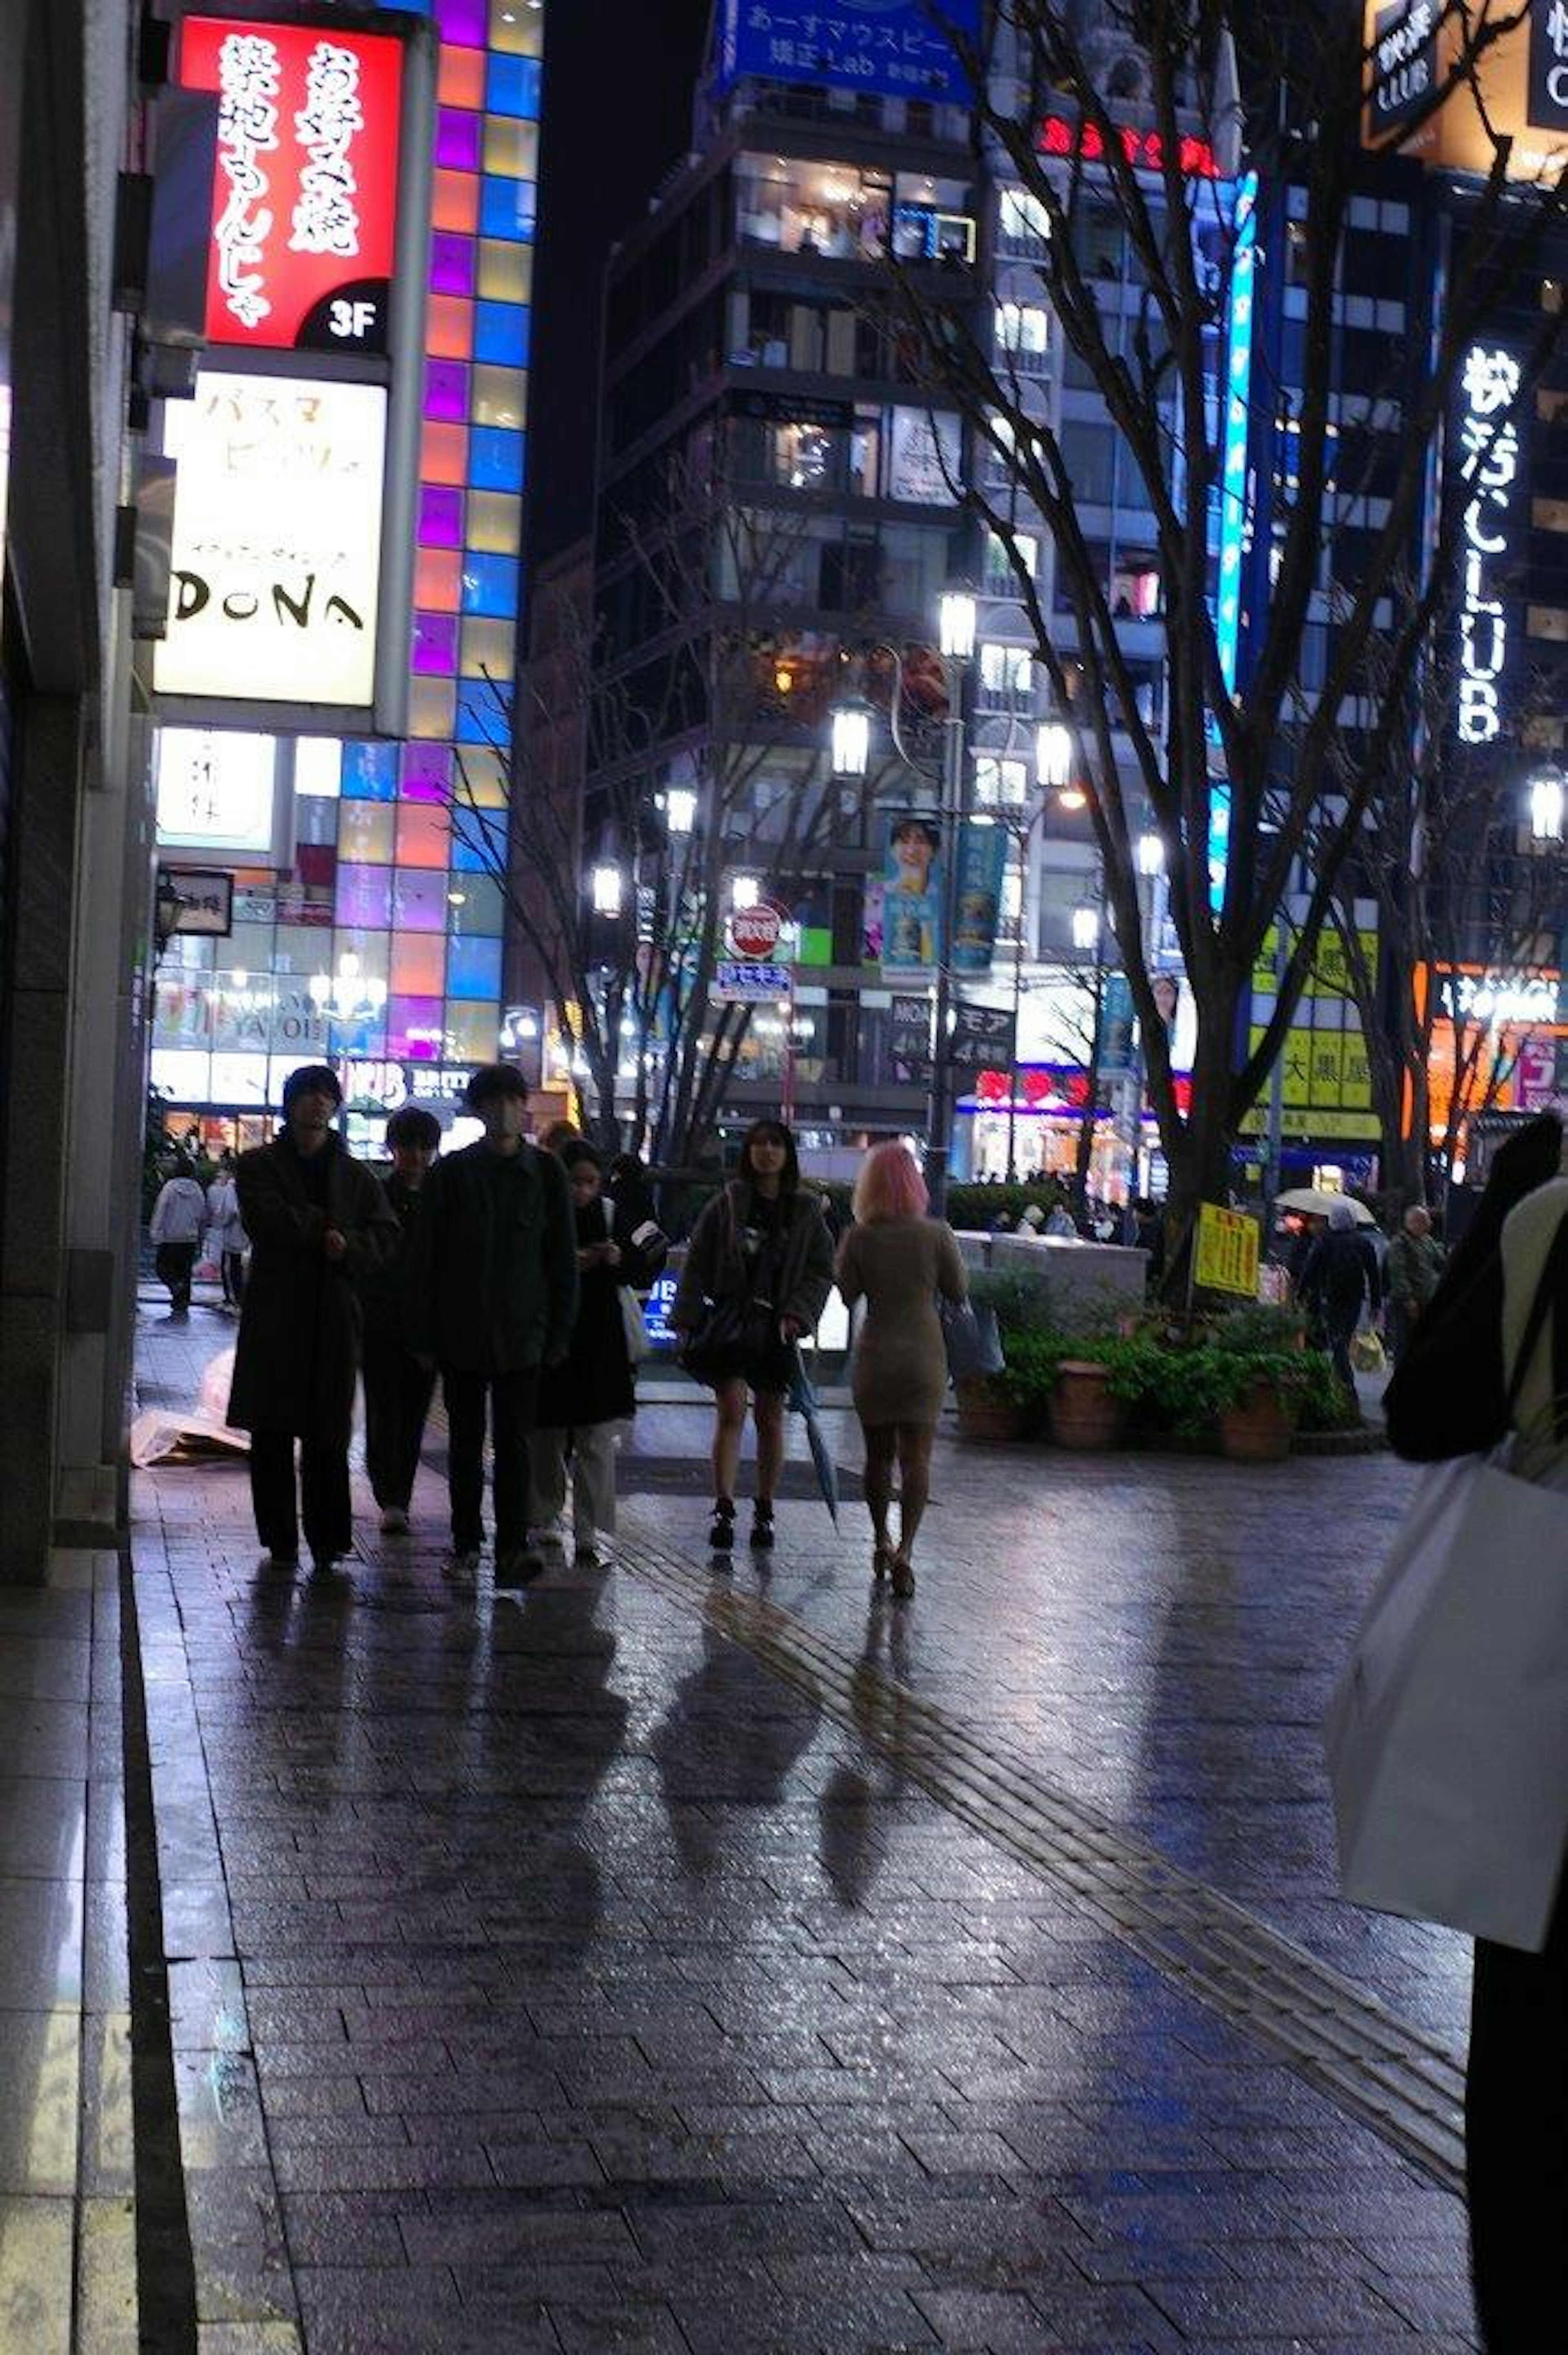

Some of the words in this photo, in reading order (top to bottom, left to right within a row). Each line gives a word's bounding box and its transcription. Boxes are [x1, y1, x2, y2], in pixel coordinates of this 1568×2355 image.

[328, 299, 376, 338] 3F
[172, 569, 363, 630] DONA
[962, 1008, 1010, 1034] モア
